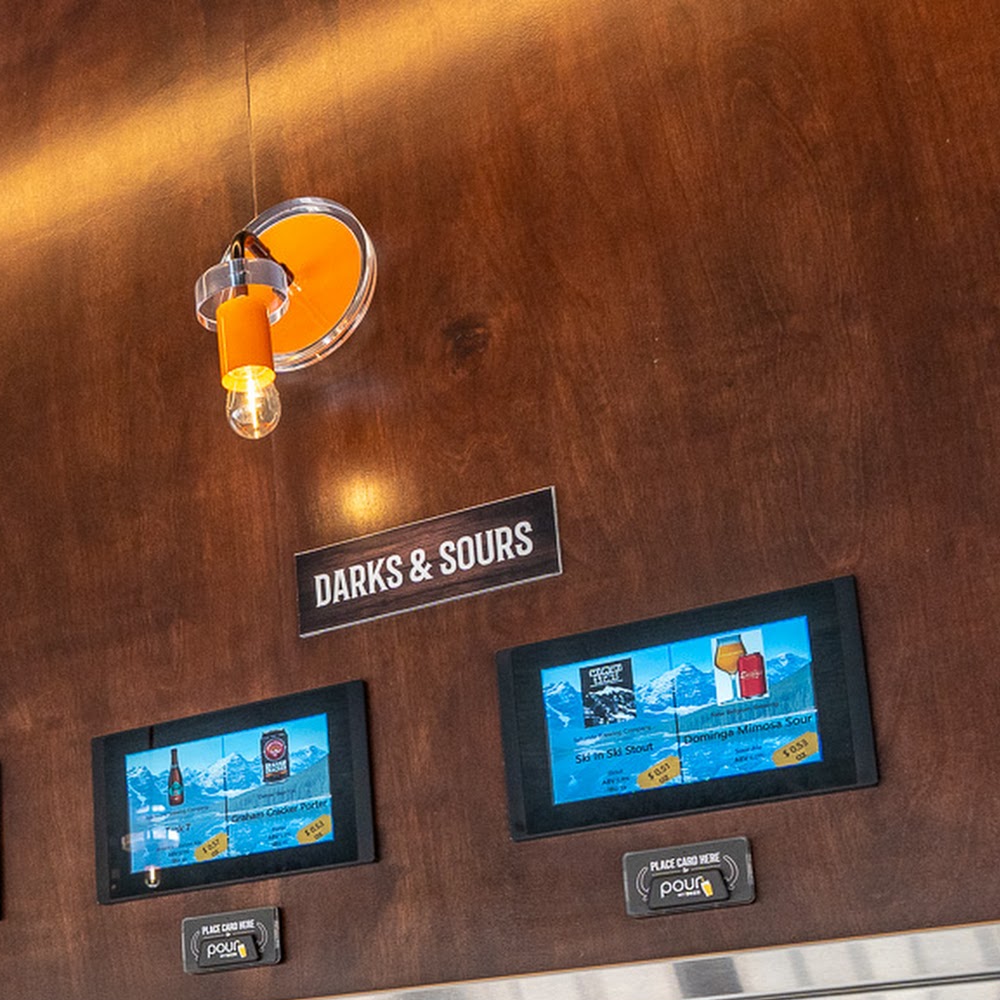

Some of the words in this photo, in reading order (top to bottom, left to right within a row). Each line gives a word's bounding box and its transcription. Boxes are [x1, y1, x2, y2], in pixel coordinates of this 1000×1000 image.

[314, 554, 403, 608] DARKS
[409, 548, 433, 583] &
[439, 521, 533, 575] SOURS
[684, 730, 735, 744] Dominga
[737, 720, 783, 735] Mimosa
[785, 715, 813, 726] Sour
[575, 752, 591, 764] Ski
[606, 747, 622, 759] Ski
[625, 743, 654, 755] Stout
[231, 811, 265, 822] Graham
[266, 805, 299, 817] Cracker
[300, 800, 329, 811] Porter
[650, 858, 675, 872] PLACE
[676, 855, 698, 867] CARD
[699, 851, 720, 864] HERE
[660, 875, 704, 899] pour
[202, 924, 221, 935] PLACE
[207, 940, 241, 959] pour
